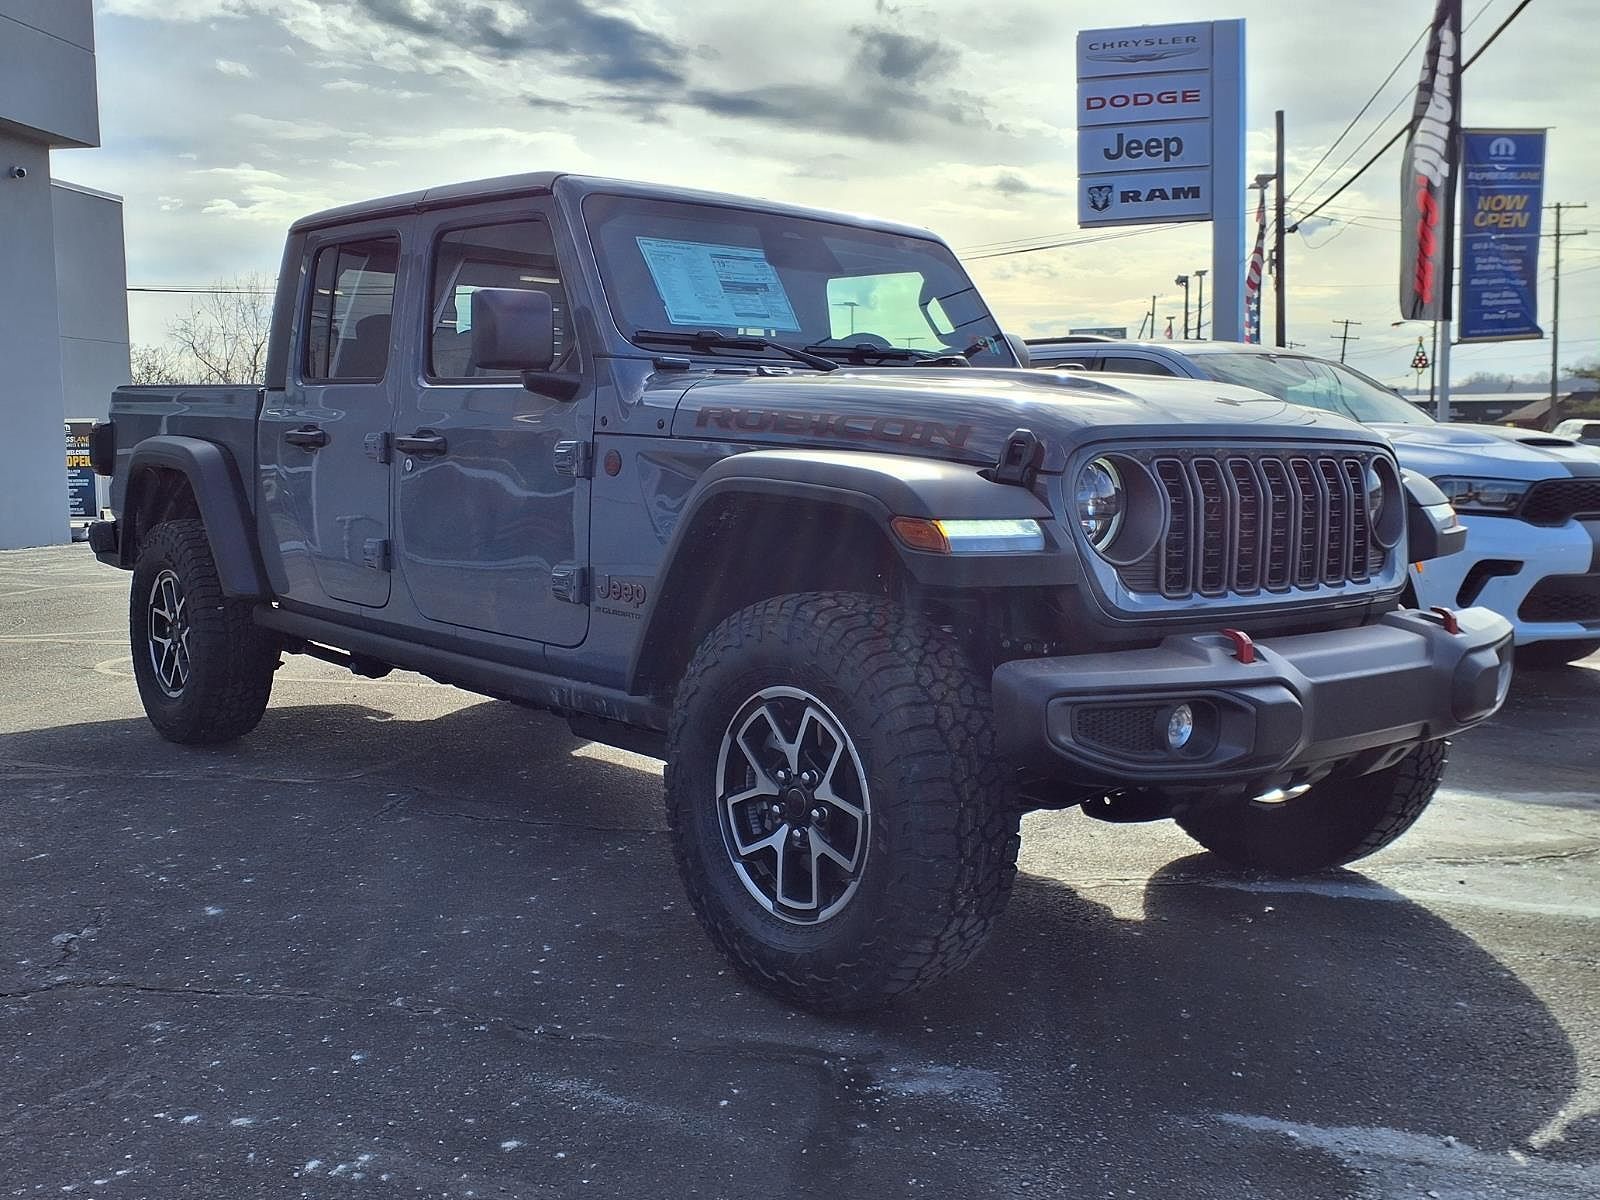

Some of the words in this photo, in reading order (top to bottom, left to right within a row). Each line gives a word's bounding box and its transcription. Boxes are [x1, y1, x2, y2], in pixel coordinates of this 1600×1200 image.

[1088, 36, 1199, 51] CHRYSLER
[1086, 90, 1200, 111] DODGE
[1103, 133, 1184, 162] Jeep
[1120, 186, 1200, 204] RAM
[1478, 194, 1529, 210] NOW
[1474, 211, 1530, 229] OPEN
[695, 406, 974, 448] RUBICON
[595, 574, 647, 609] Jeep
